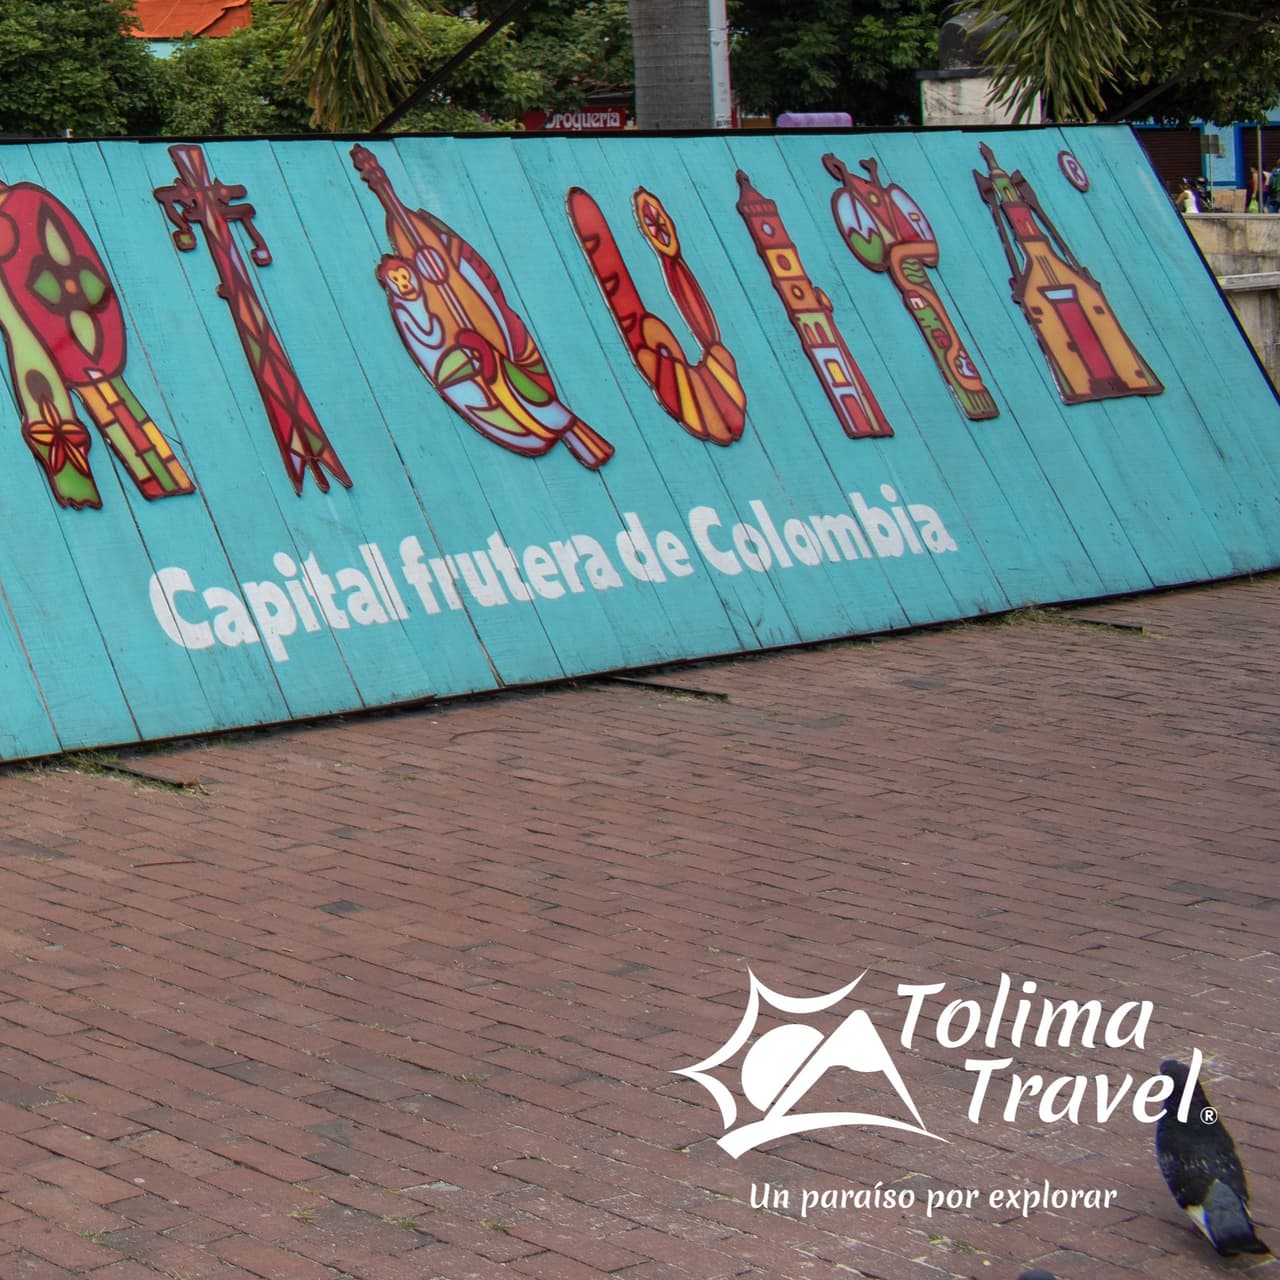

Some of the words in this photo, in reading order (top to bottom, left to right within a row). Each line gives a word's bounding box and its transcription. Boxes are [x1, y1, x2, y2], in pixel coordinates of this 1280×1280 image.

[149, 543, 410, 663] Capital
[399, 535, 624, 615] frutera
[617, 511, 695, 584] de
[688, 483, 959, 576] Colombia
